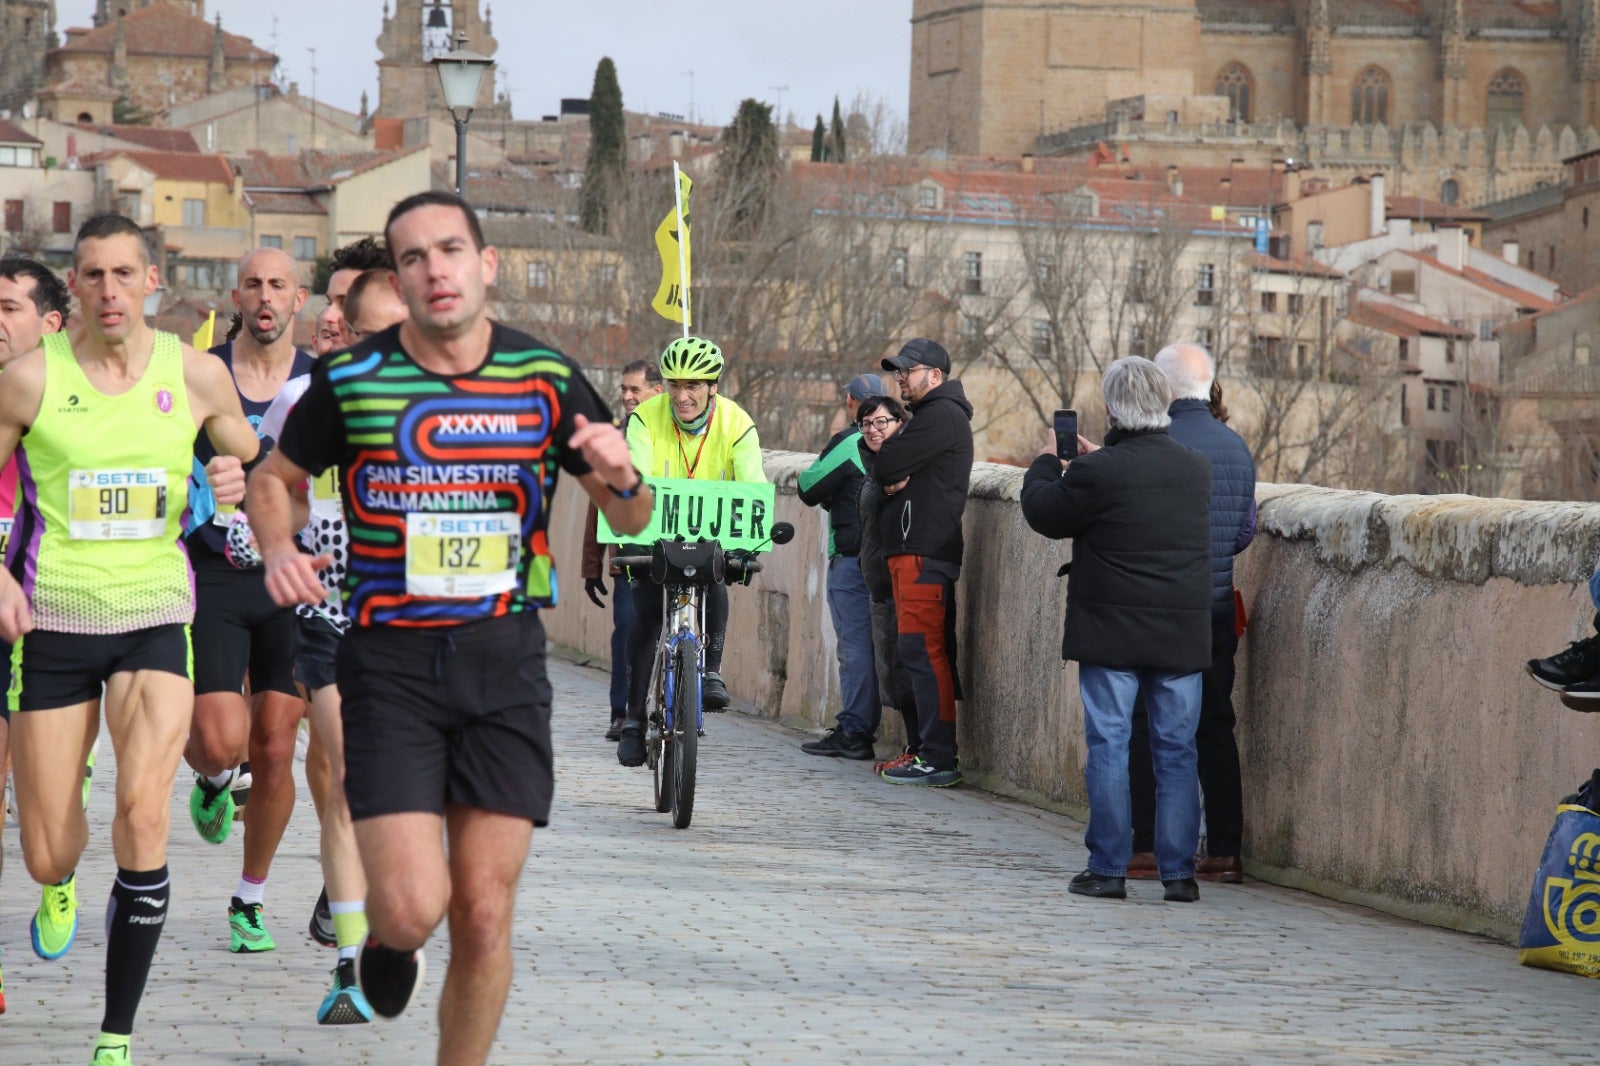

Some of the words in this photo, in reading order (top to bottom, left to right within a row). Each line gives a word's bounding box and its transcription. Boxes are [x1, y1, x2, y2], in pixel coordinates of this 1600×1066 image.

[437, 414, 518, 434] XXXVIII
[97, 472, 159, 485] SETEL
[366, 464, 401, 485] SAN
[406, 464, 520, 485] SILVESTRE
[100, 487, 128, 515] 90
[366, 488, 499, 511] SALMANTINA
[440, 519, 510, 533] SETEL
[661, 493, 765, 540] MUJER
[438, 537, 481, 569] 132
